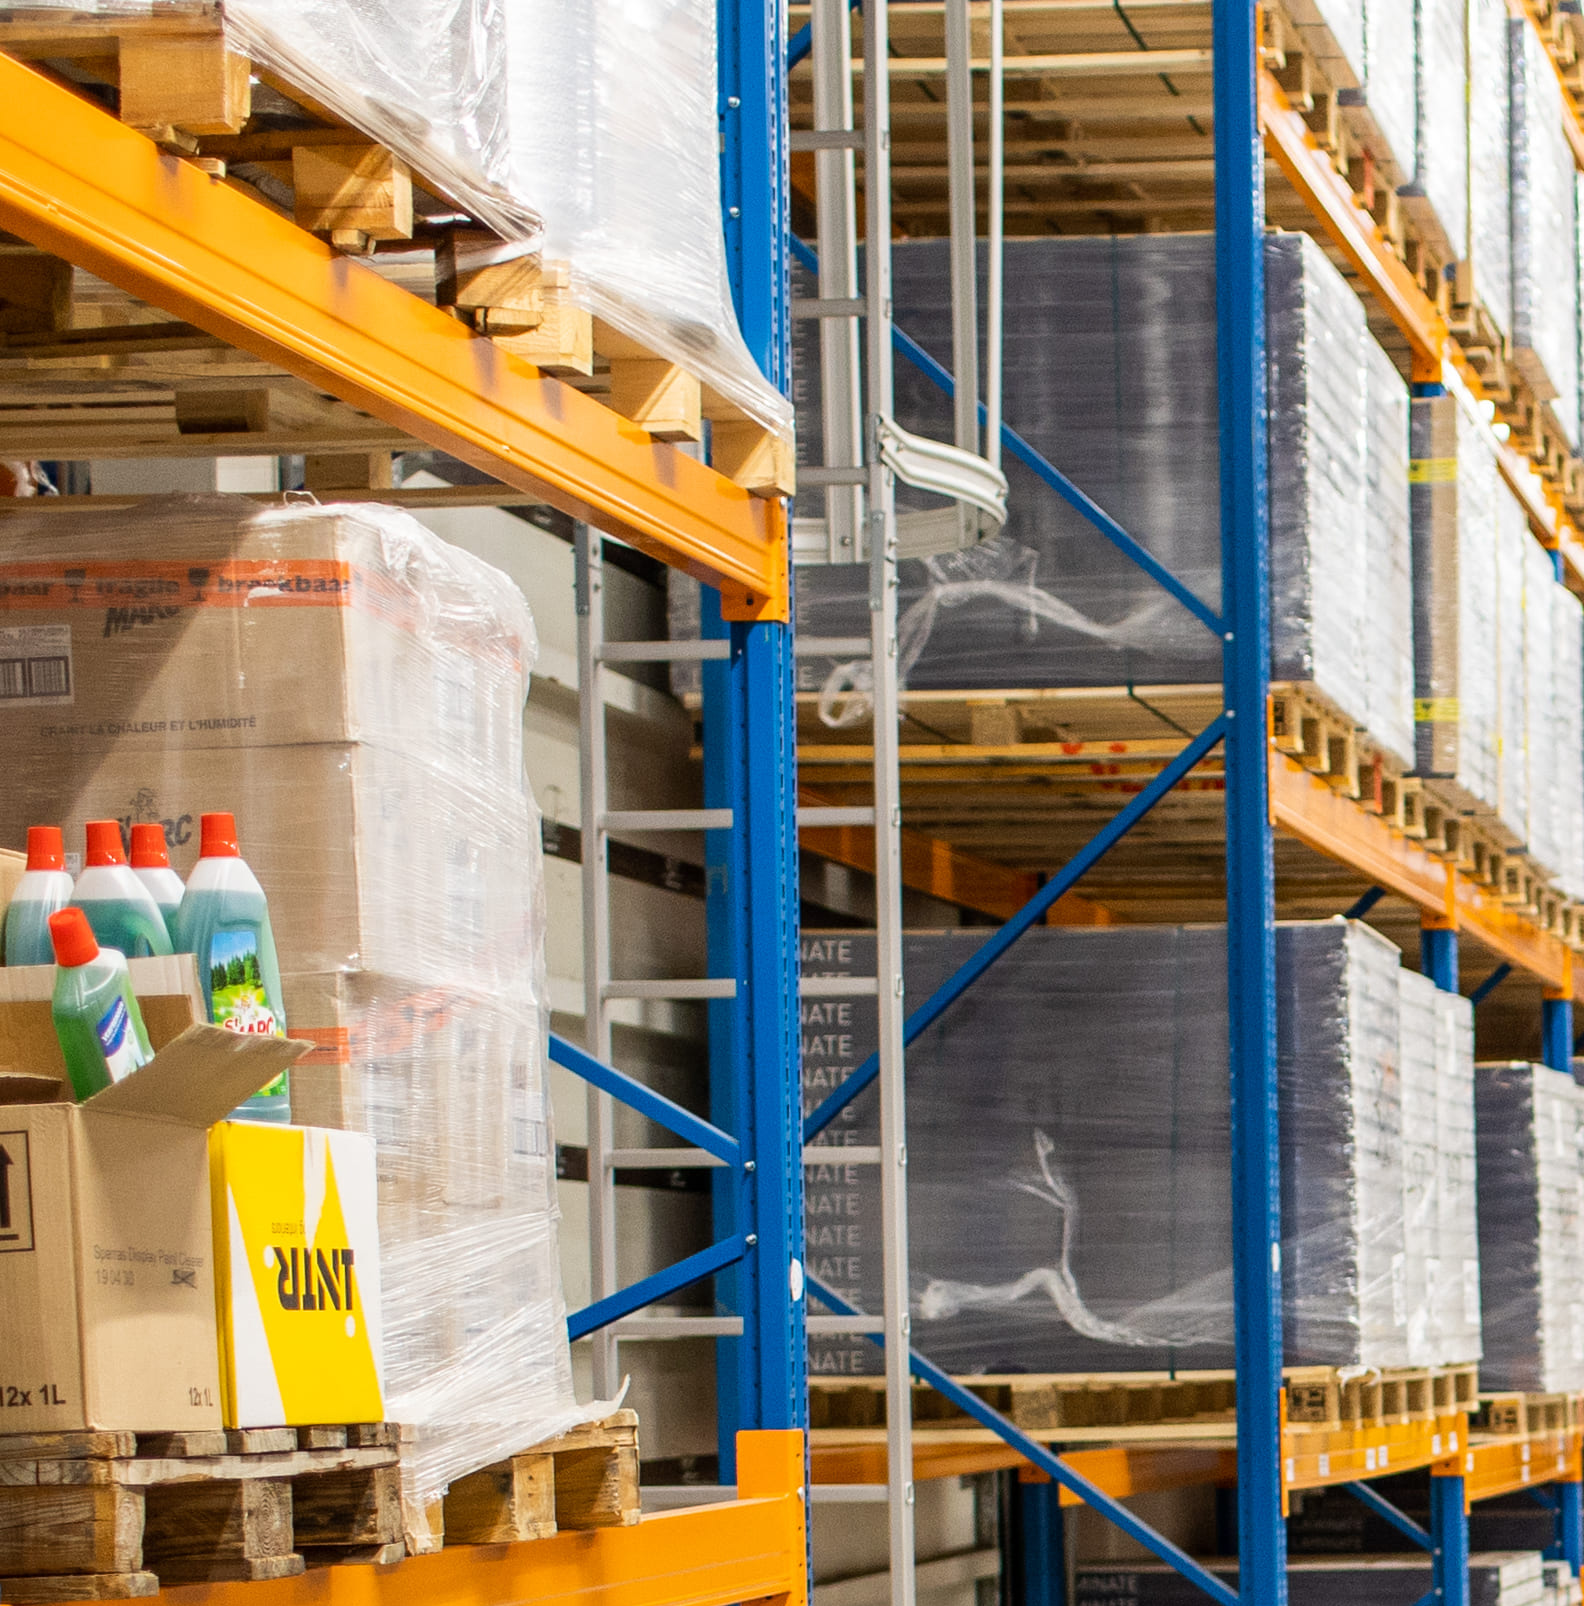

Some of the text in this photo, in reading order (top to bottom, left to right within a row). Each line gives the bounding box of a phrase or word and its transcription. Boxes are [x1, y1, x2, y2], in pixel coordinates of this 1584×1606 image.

[107, 720, 168, 735] CHALEUR
[170, 719, 186, 732] ET
[40, 1384, 66, 1406] 1L
